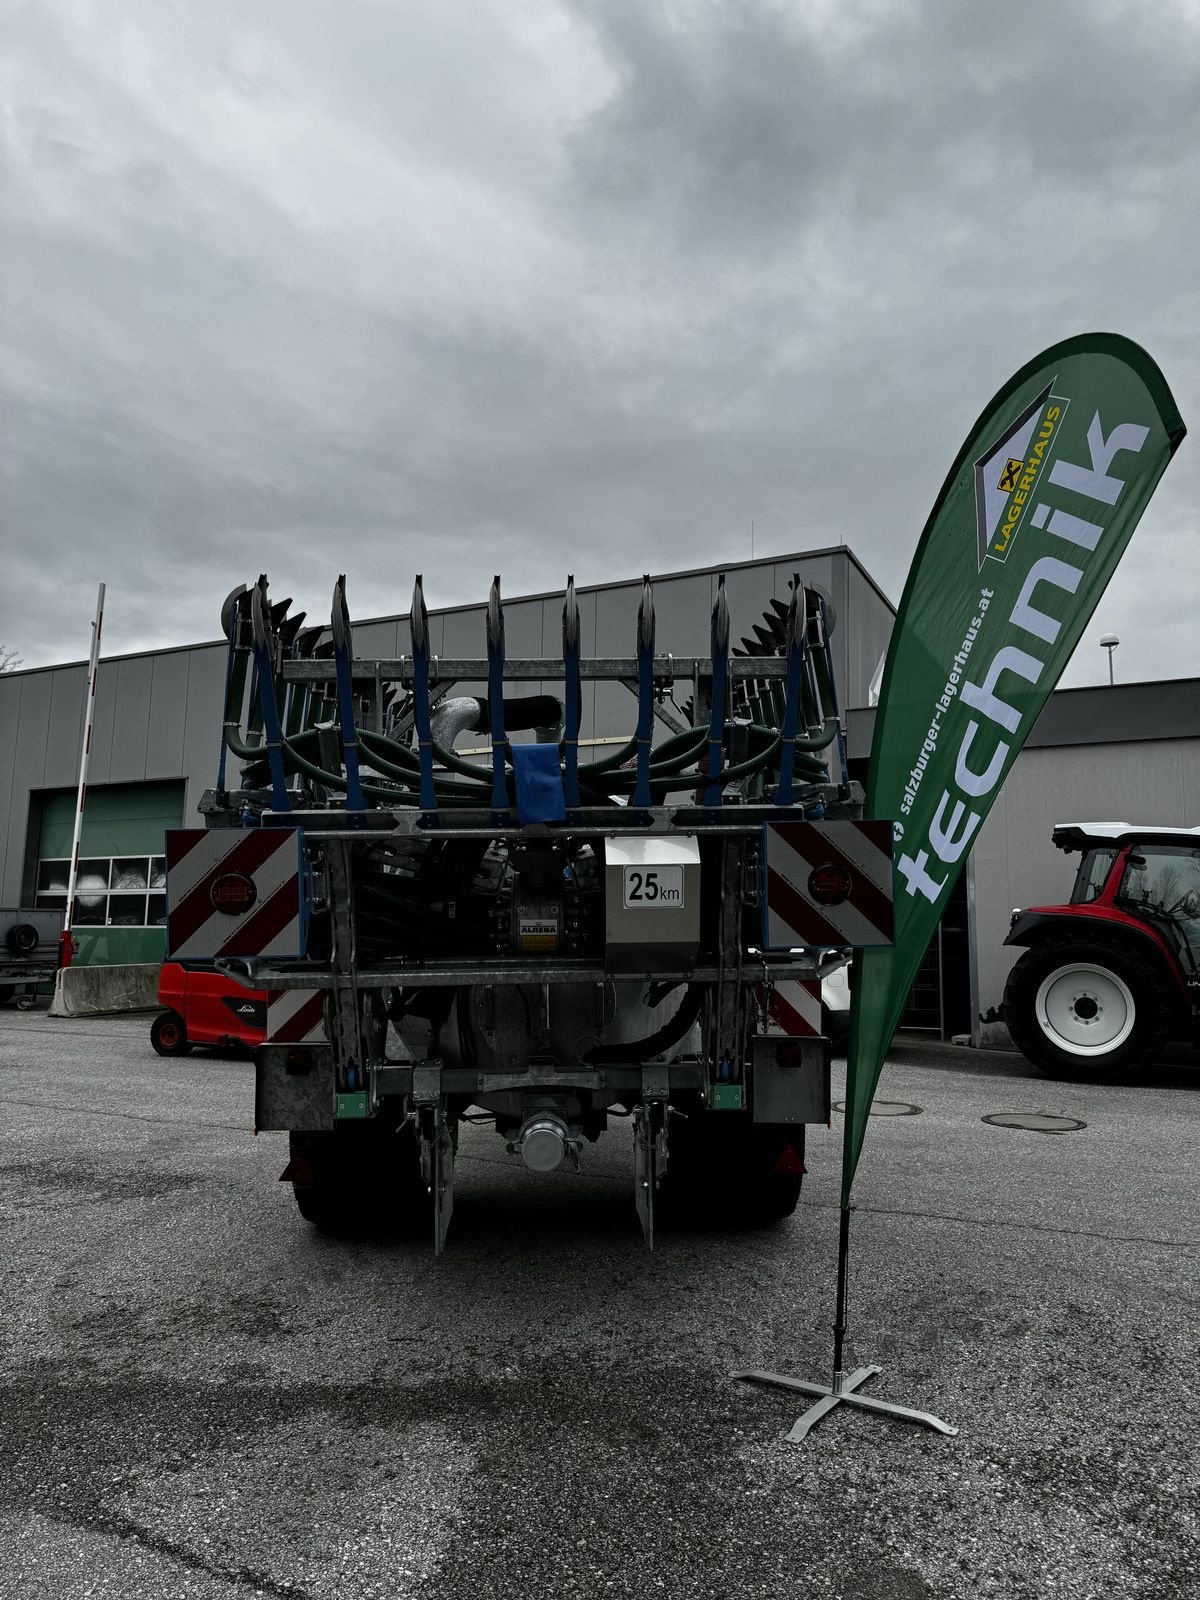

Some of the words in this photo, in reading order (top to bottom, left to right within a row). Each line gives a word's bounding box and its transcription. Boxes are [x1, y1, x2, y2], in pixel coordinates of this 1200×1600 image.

[994, 405, 1061, 552] LAGERHAUS
[897, 409, 1150, 905] technik
[900, 587, 994, 816] salzburger-lagerhaus.at
